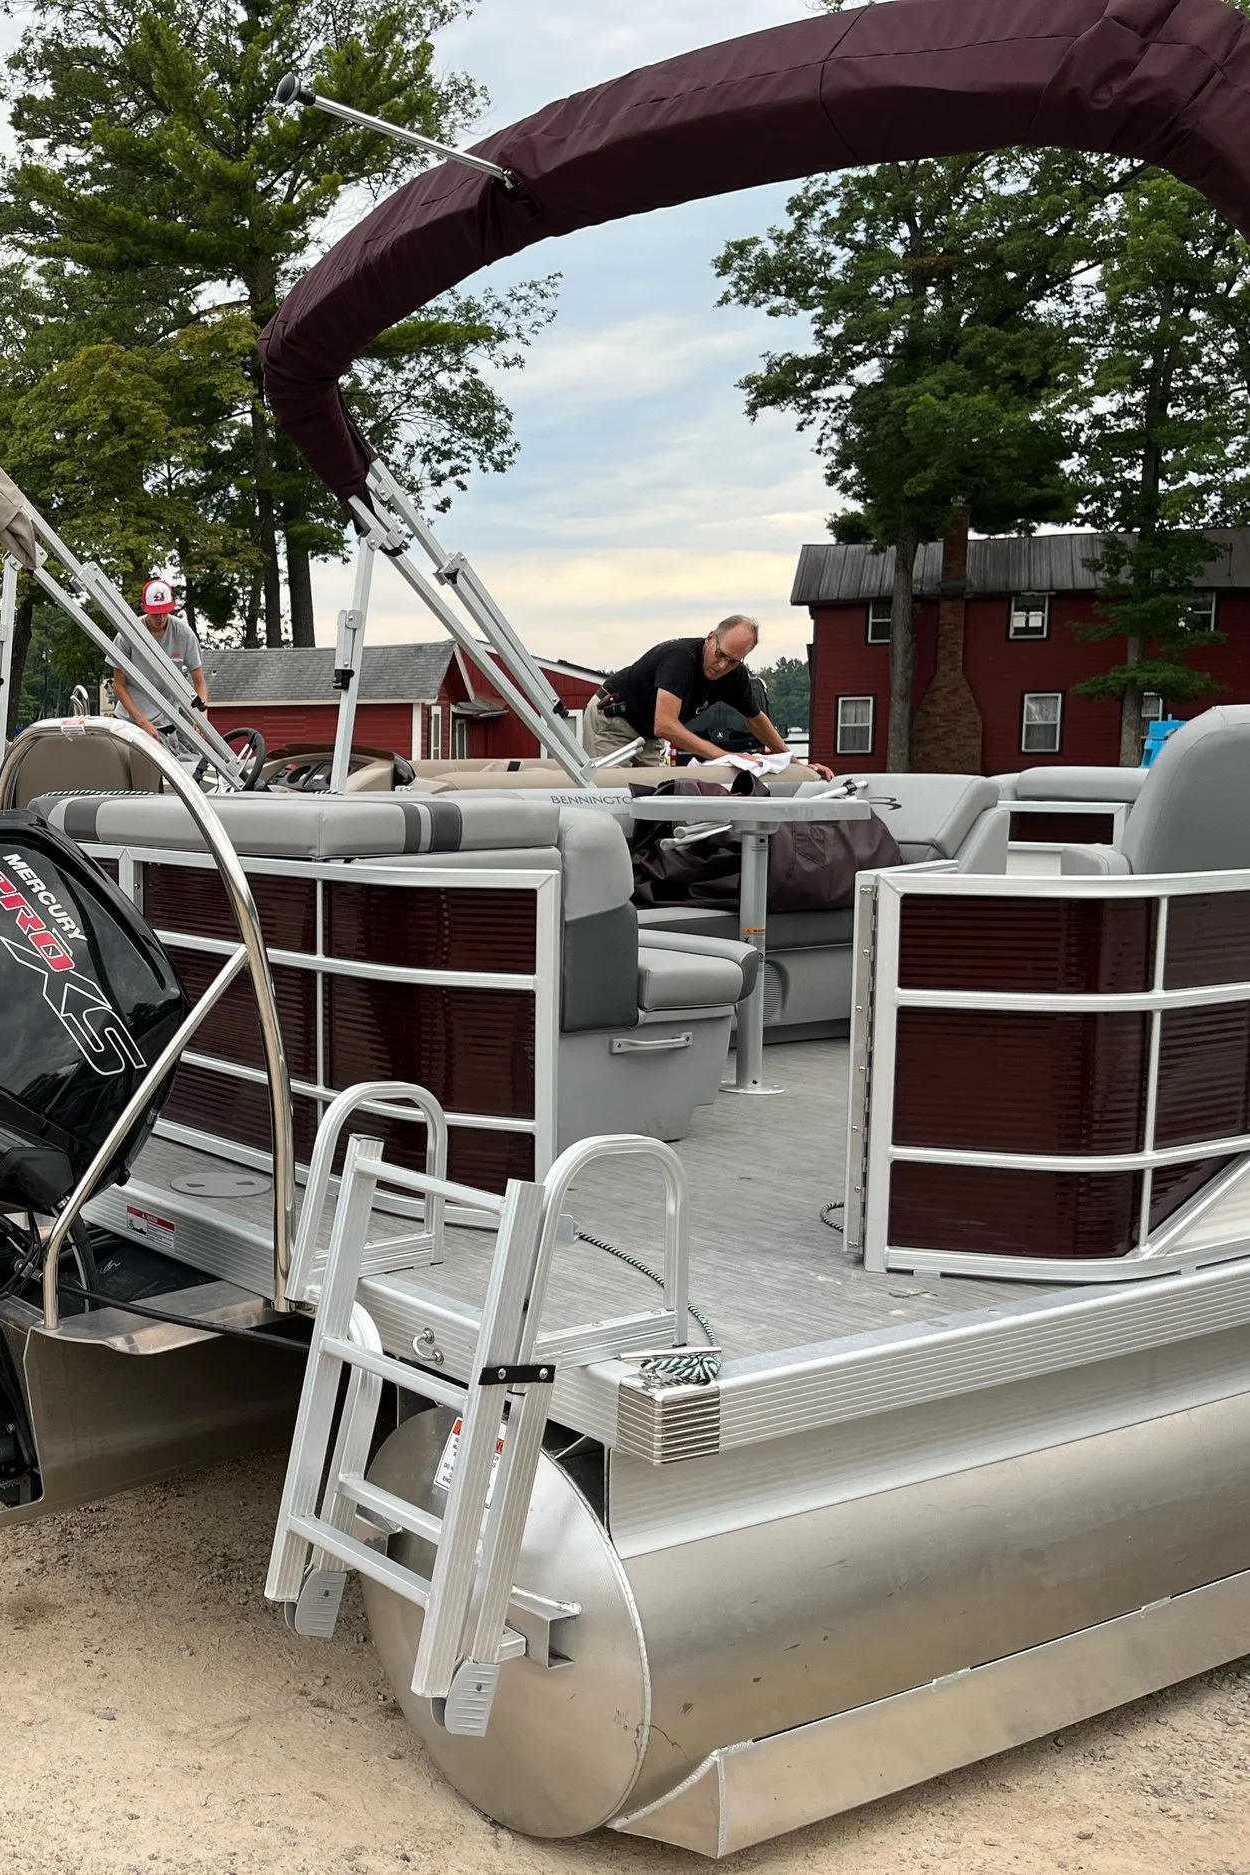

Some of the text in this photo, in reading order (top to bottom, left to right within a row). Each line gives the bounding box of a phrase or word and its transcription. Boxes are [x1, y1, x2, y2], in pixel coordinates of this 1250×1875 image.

[550, 795, 632, 805] BENNINGTO
[2, 853, 88, 942] MERCURY
[0, 928, 147, 1076] XS
